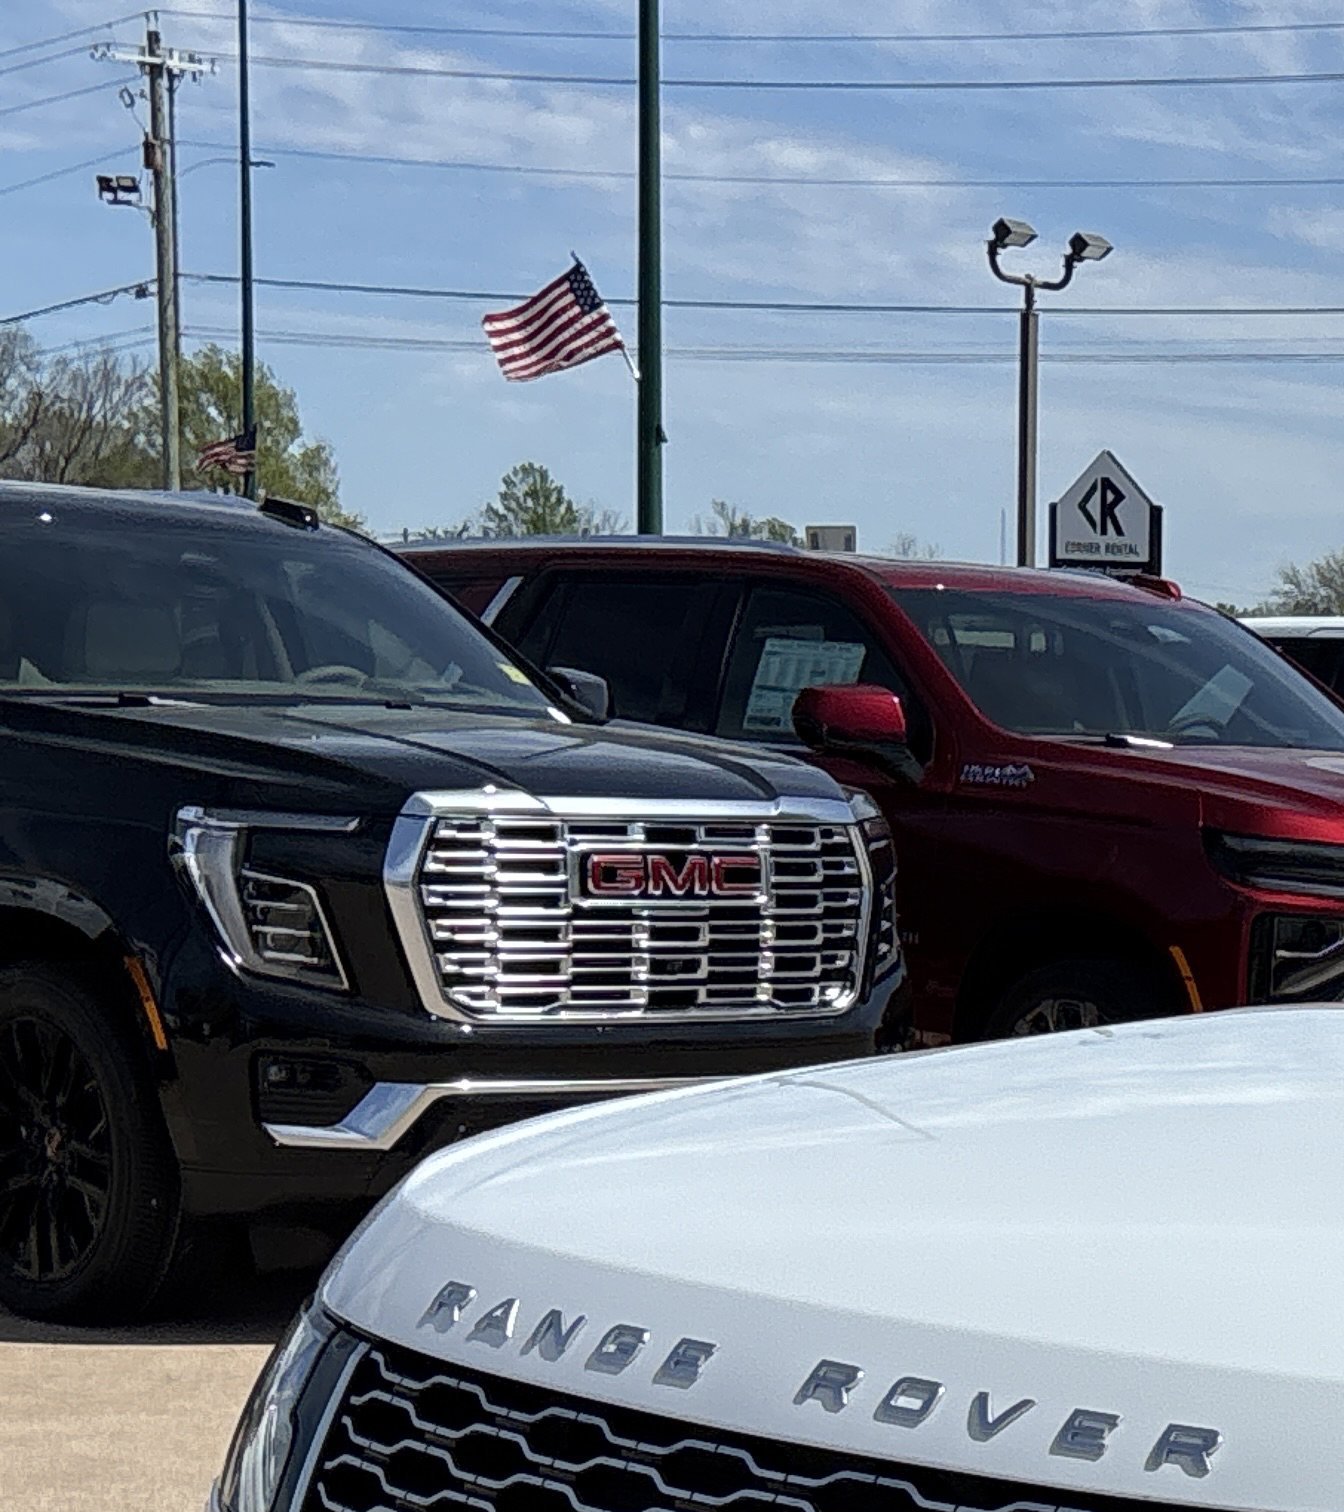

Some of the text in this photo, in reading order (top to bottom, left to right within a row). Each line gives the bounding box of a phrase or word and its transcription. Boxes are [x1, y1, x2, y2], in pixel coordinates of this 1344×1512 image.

[587, 854, 761, 896] GMC
[416, 1280, 1224, 1479] RANGE ROVER
